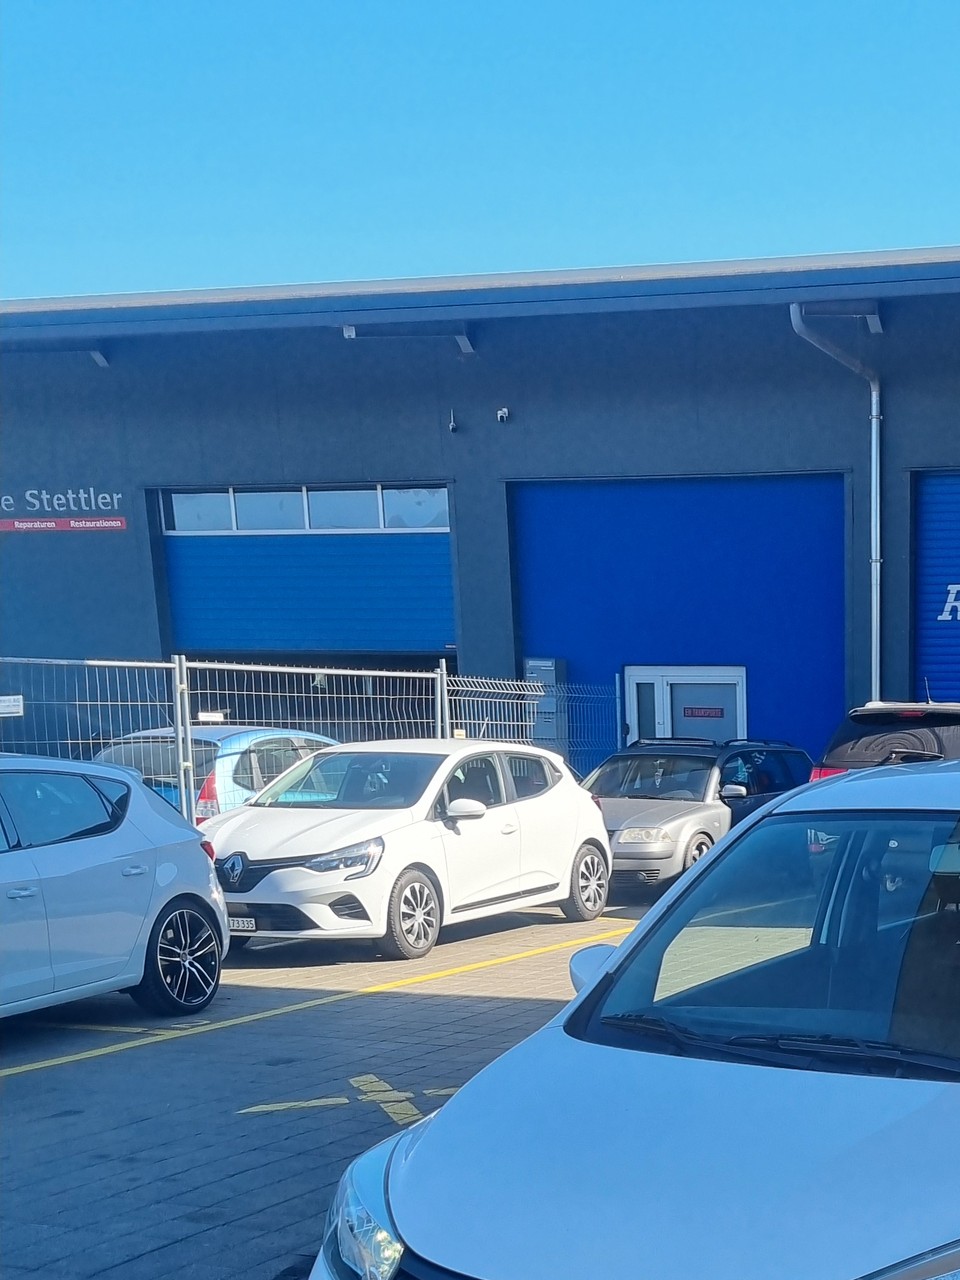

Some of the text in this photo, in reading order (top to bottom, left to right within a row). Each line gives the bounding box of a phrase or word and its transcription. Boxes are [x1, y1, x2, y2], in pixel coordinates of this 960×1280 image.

[25, 487, 122, 511] Stettler
[14, 519, 122, 530] Reparaturen Restaurationen
